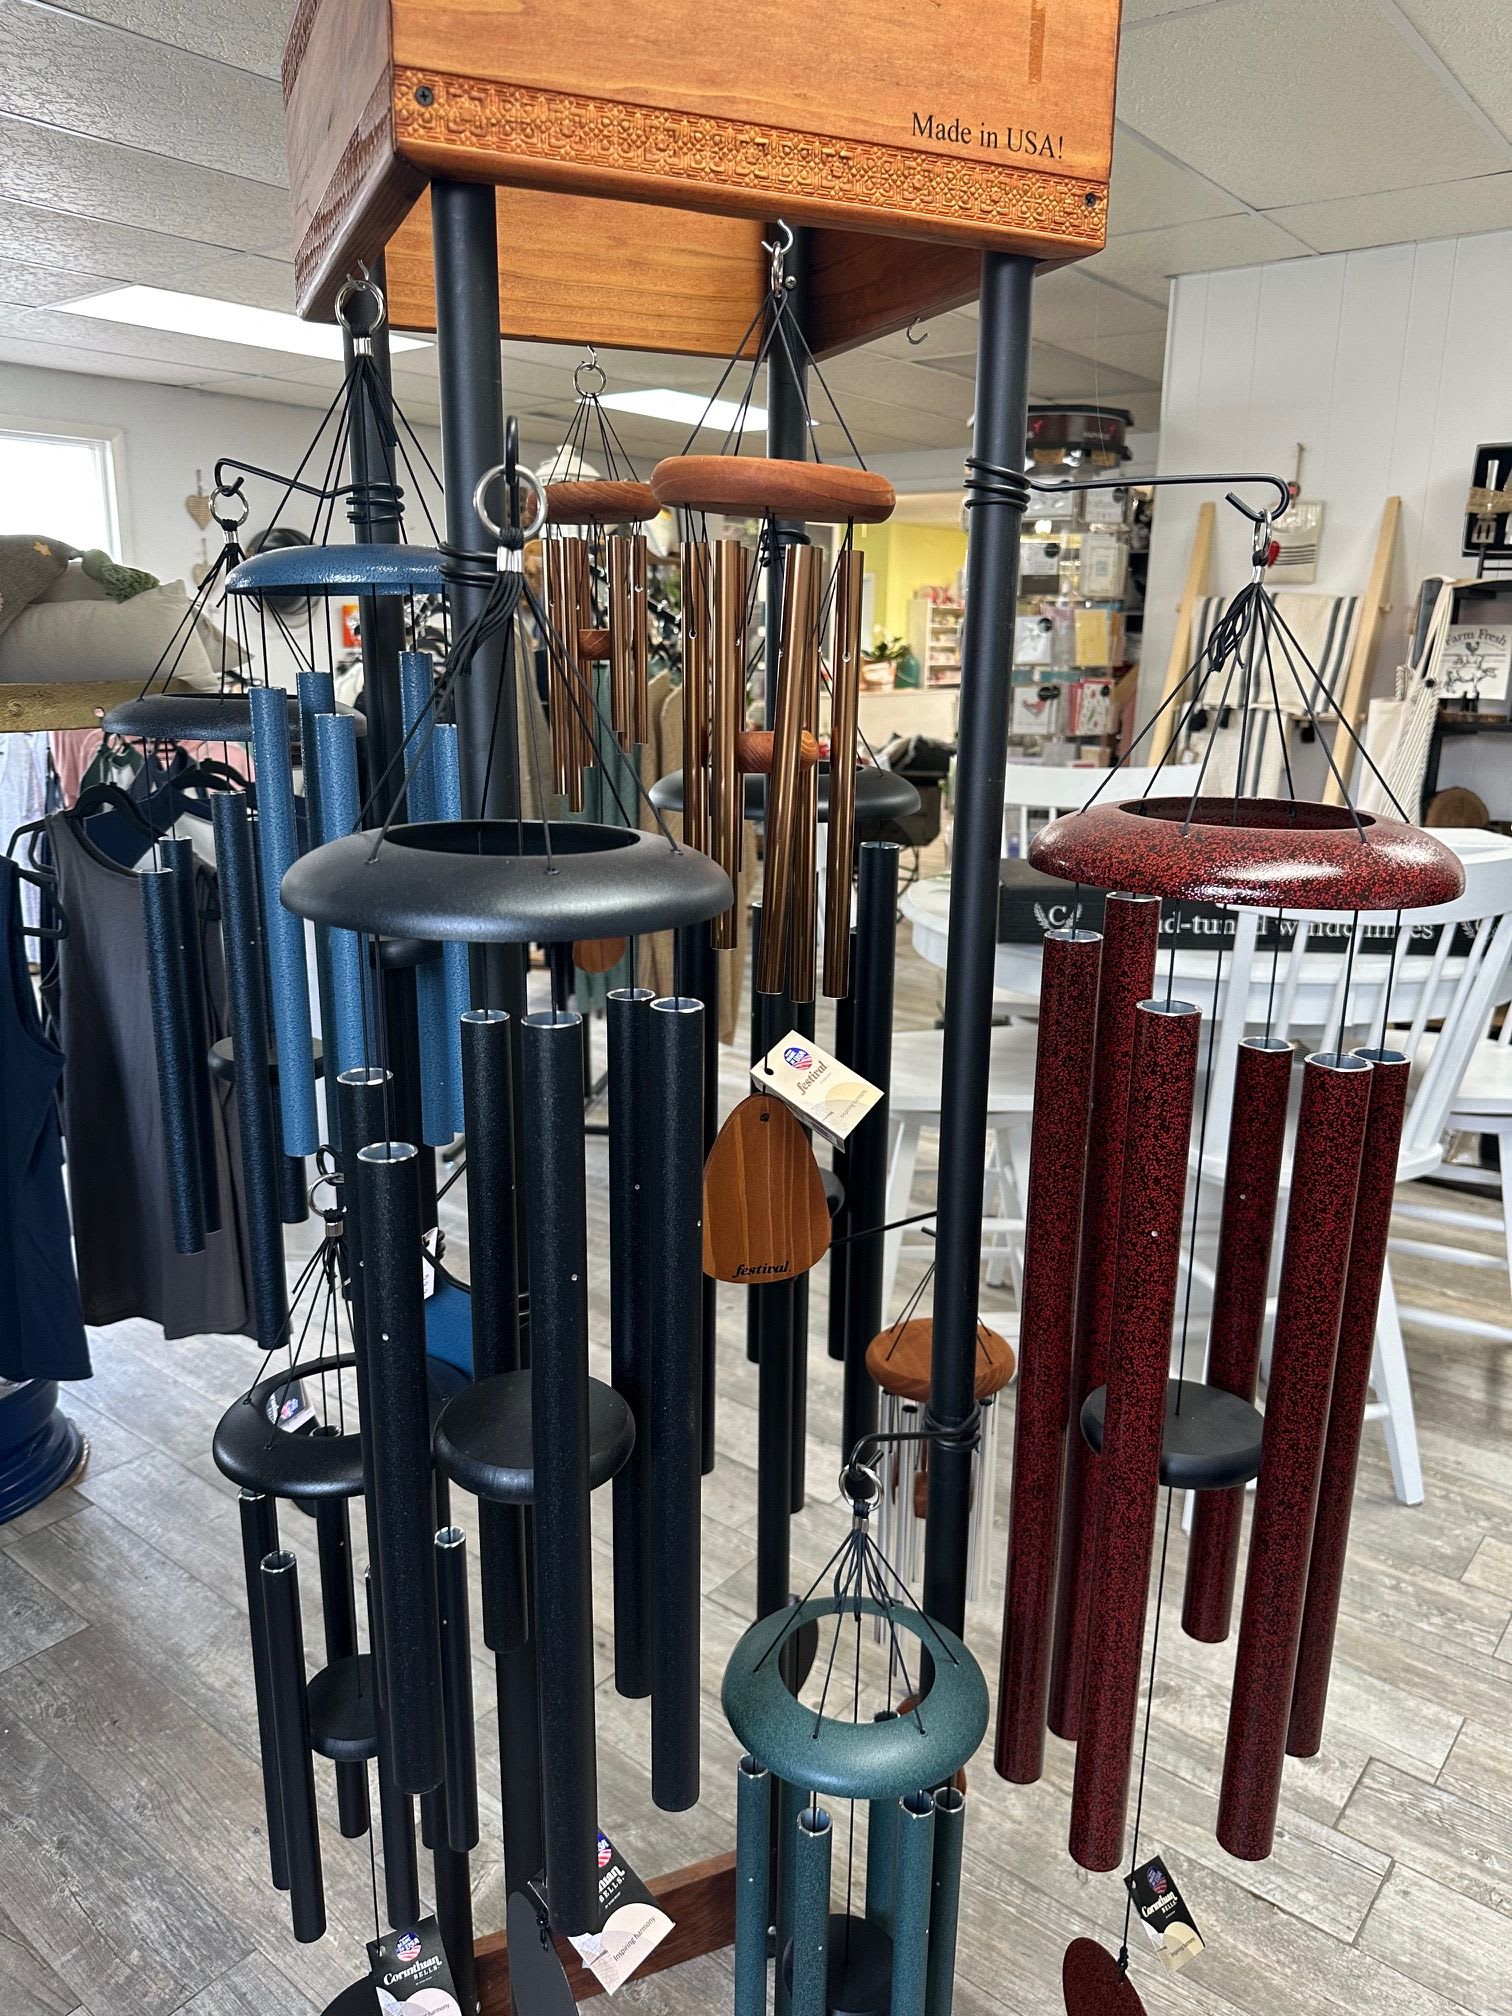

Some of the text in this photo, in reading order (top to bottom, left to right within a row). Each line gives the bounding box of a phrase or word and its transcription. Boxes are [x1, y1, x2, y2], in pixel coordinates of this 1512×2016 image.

[911, 111, 1064, 160] Made in USA!
[1478, 628, 1507, 647] Fresh
[796, 1060, 828, 1096] festival
[612, 1936, 637, 1962] Inspiring
[383, 1954, 443, 1986] Corinthian
